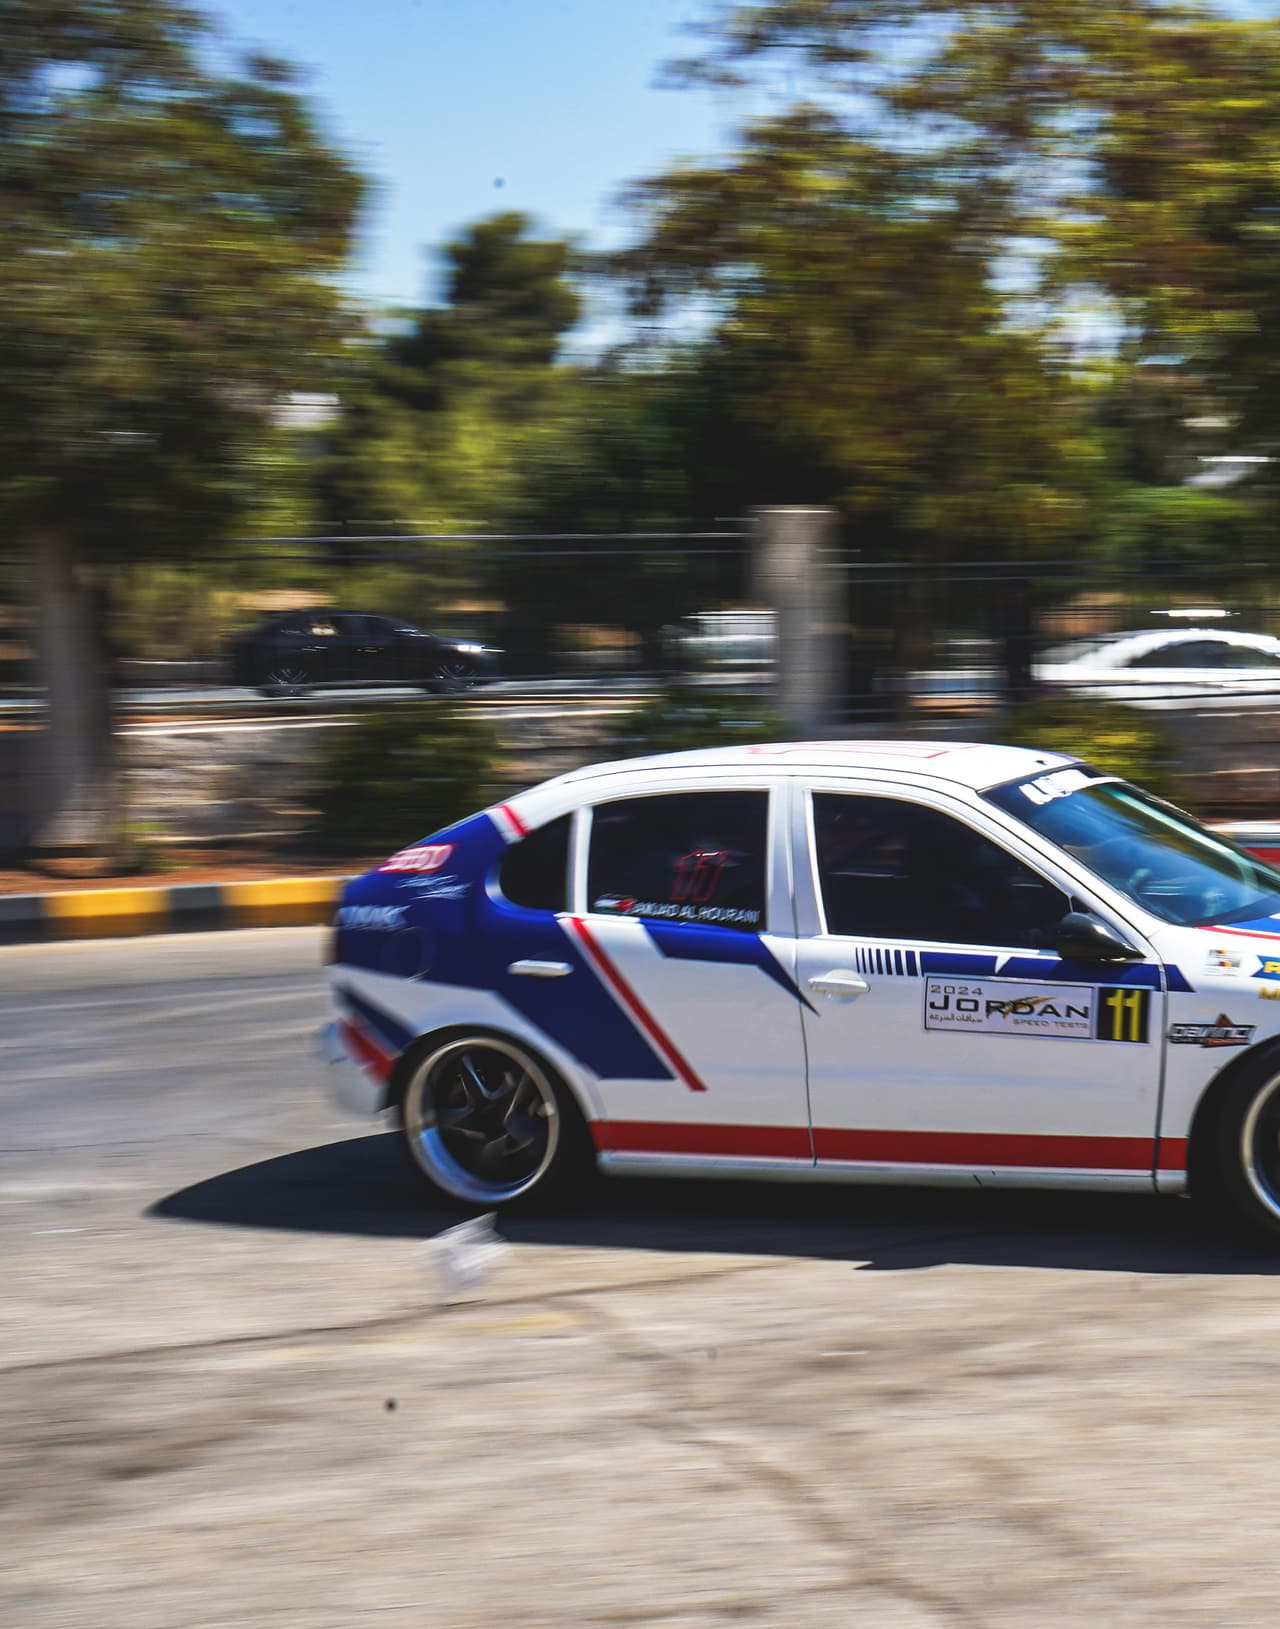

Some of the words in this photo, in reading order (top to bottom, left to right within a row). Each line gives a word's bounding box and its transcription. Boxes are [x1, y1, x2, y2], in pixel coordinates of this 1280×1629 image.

[930, 984, 983, 995] 2024
[929, 995, 1089, 1019] JORDAN
[1106, 989, 1142, 1041] 11
[1013, 1019, 1049, 1028] SPEED
